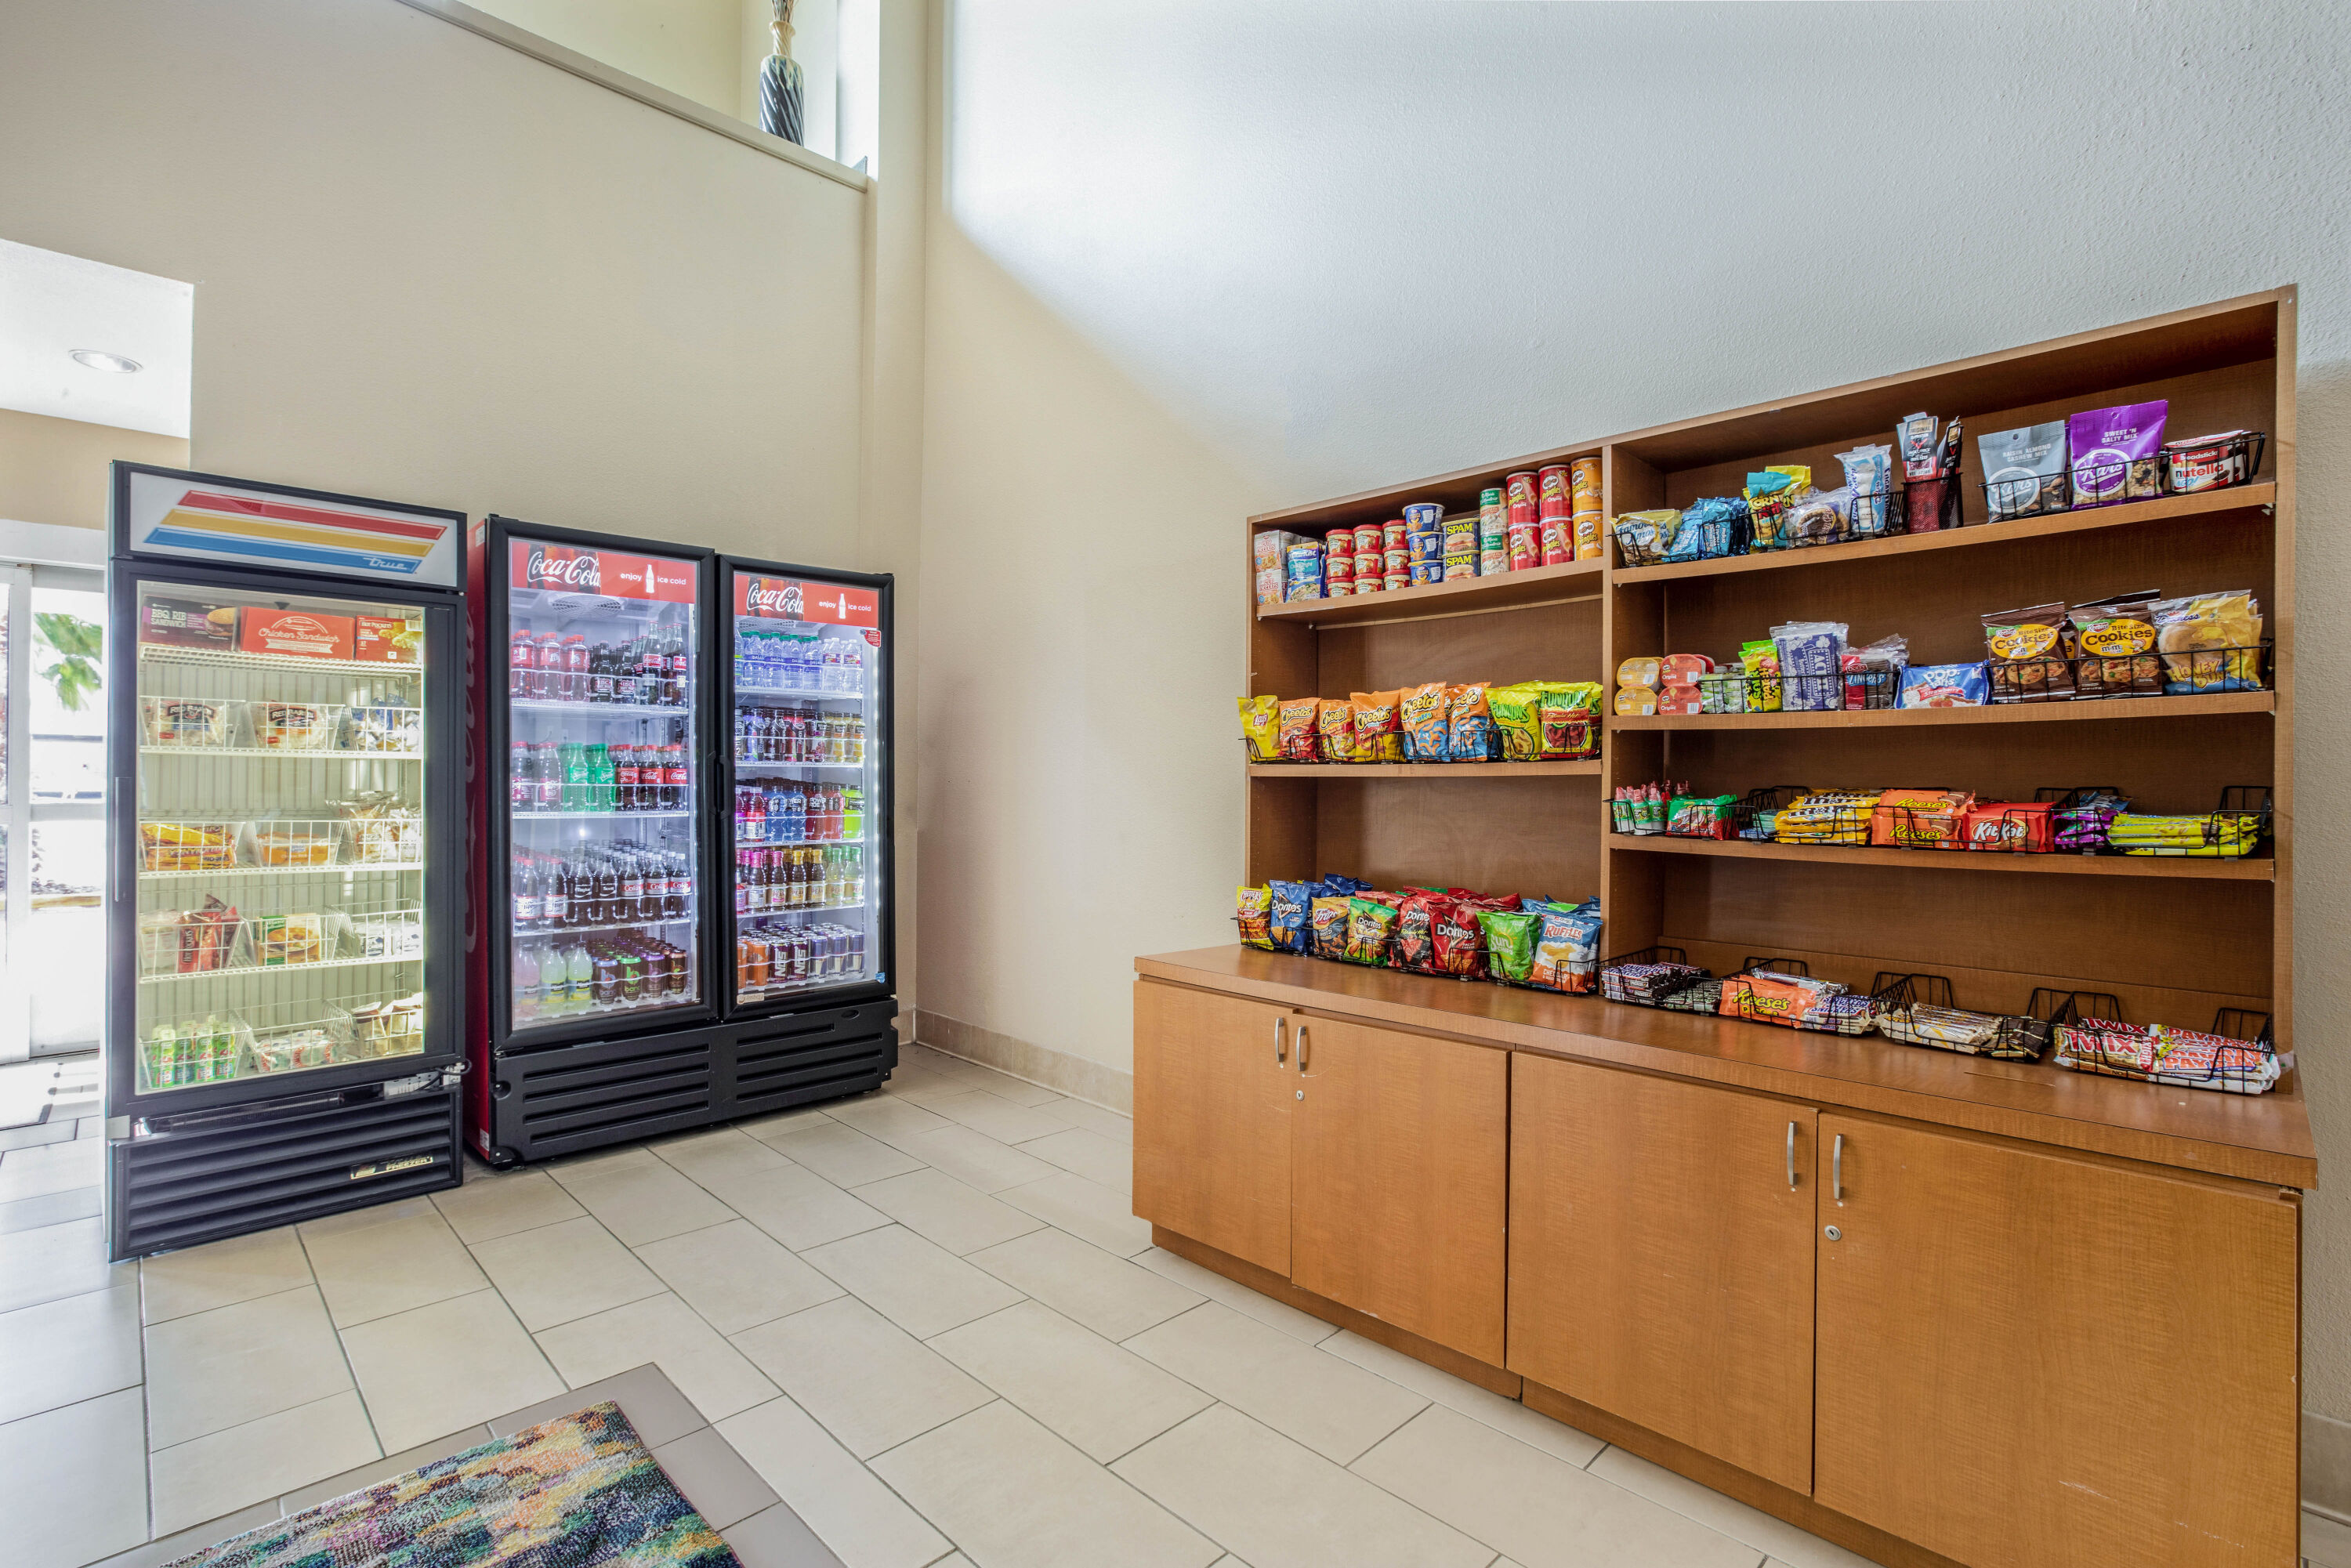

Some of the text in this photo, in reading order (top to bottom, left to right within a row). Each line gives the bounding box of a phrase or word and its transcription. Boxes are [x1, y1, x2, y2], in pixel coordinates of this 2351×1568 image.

[2104, 429, 2128, 437] SWEET
[2025, 444, 2052, 453] ALMOND
[2007, 454, 2032, 462] CASHEW
[2175, 463, 2224, 478] nutella
[1509, 493, 1527, 506] Pringles
[1542, 486, 1562, 502] Pringles
[1749, 494, 1780, 510] CORN
[1447, 523, 1473, 535] SPAM
[1542, 540, 1561, 554] Pringles
[1577, 533, 1599, 546] Pringles
[1510, 544, 1527, 557] Pringles
[363, 556, 408, 570] true
[1446, 554, 1473, 567] SPAM
[527, 552, 601, 588] Coca-Cola
[620, 572, 643, 582] enjoy
[746, 583, 804, 614] Coca-Cola
[150, 609, 170, 620] BBQ
[172, 610, 187, 621] RIB
[150, 617, 187, 628] SANDWICH
[258, 627, 340, 644] Chicken Sandwich
[1994, 632, 2055, 650] Cookies
[2085, 629, 2154, 646] Cookies
[1813, 654, 1828, 675] ACT
[2166, 660, 2220, 683] HONEY
[2193, 671, 2225, 689] BUN
[1400, 690, 1440, 722] Cheetos
[1541, 690, 1587, 710] FUNYUNS
[1281, 708, 1313, 726] Cheetos
[1355, 707, 1392, 731] Cheetos
[1412, 712, 1433, 724] Puffs
[1894, 798, 1949, 809] Reese's
[1889, 824, 1943, 840] Reese's
[1272, 900, 1302, 914] Doritos
[1357, 917, 1382, 929] Doritos
[1436, 923, 1475, 940] Doritos
[1543, 923, 1584, 940] RUFFLES
[1733, 989, 1791, 1011] Reese's
[2081, 1017, 2148, 1034] TWIX
[2063, 1030, 2138, 1054] TWIX
